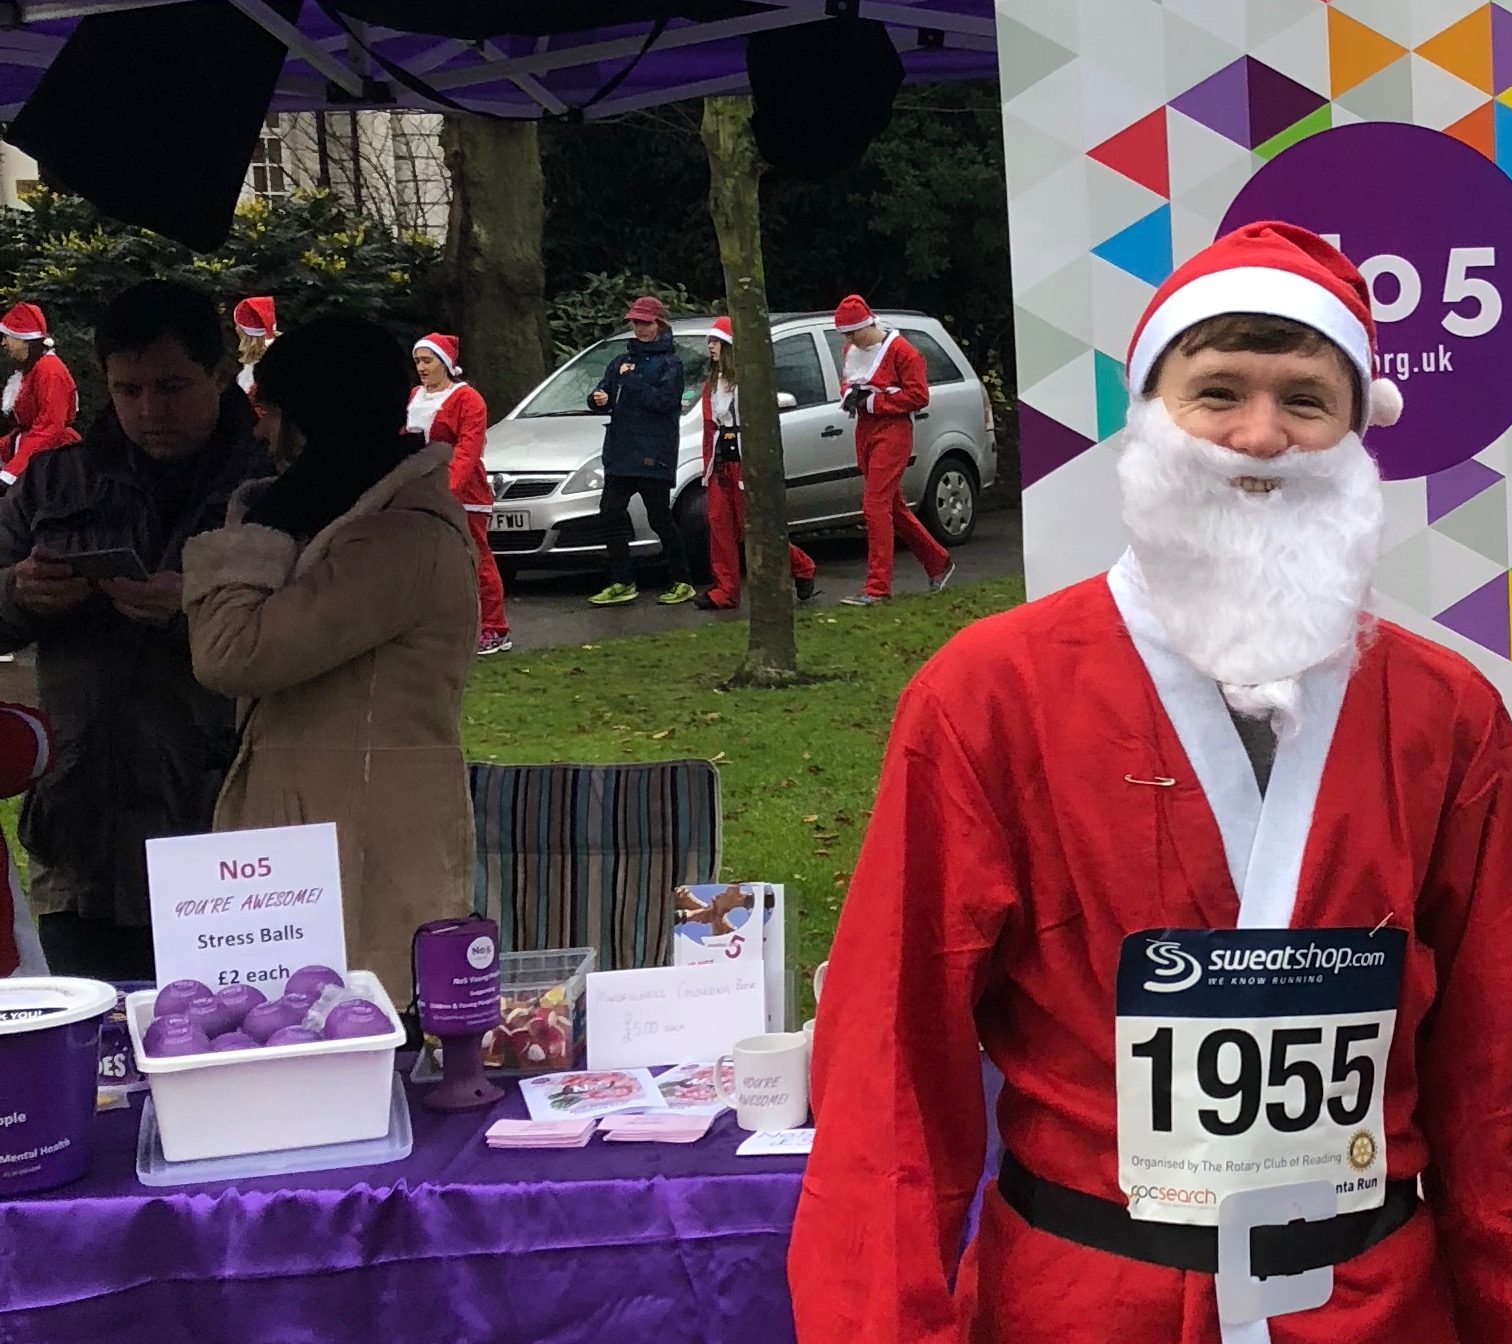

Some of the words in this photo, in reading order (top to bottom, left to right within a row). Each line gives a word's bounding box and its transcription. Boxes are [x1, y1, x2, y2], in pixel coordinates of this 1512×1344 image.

[1441, 247, 1502, 337] 5
[497, 514, 524, 529] FWU
[219, 857, 272, 881] No5
[175, 896, 234, 918] YOU'RE
[241, 887, 324, 911] AWESOME!
[198, 932, 254, 950] Stress
[260, 925, 304, 943] Balls
[725, 934, 745, 959] 5
[1208, 942, 1385, 975] sweatshop.com
[218, 969, 240, 986] £2
[246, 964, 290, 983] each
[1208, 977, 1225, 986] WE
[1231, 977, 1267, 985] KNOW
[1271, 974, 1324, 985] RUNNING
[1132, 1023, 1380, 1136] 1955
[1131, 1155, 1185, 1171] Organised
[1187, 1158, 1199, 1173] by
[1201, 1160, 1223, 1173] The
[1225, 1159, 1261, 1173] Rotary
[1263, 1157, 1288, 1169] Club
[1290, 1156, 1300, 1168] of
[1302, 1153, 1342, 1166] Reading
[1130, 1184, 1217, 1205] rocsearch
[1357, 1177, 1379, 1191] Run
